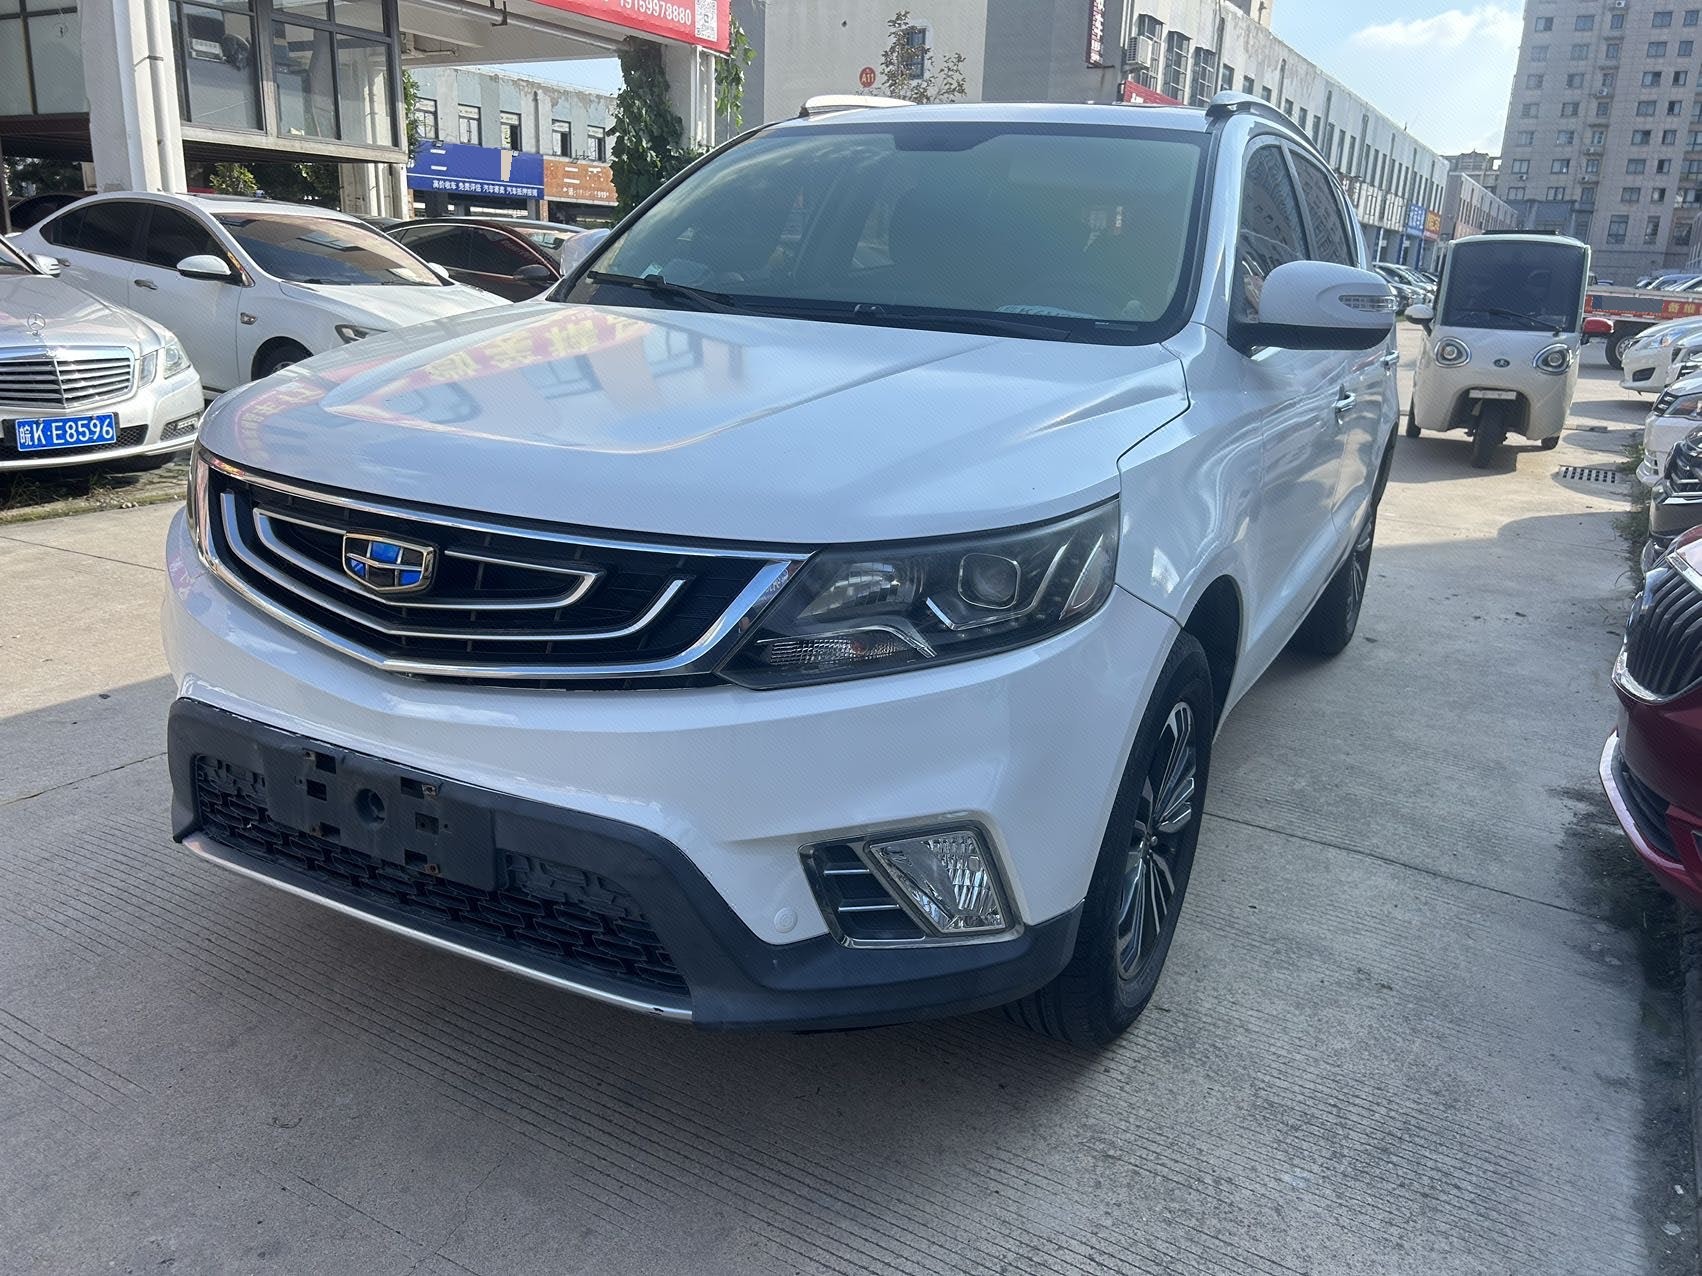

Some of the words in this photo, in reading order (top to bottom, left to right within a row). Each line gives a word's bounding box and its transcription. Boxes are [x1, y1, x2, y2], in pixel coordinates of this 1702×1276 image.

[432, 180, 457, 190] 高价收车
[458, 182, 482, 192] 免费评估
